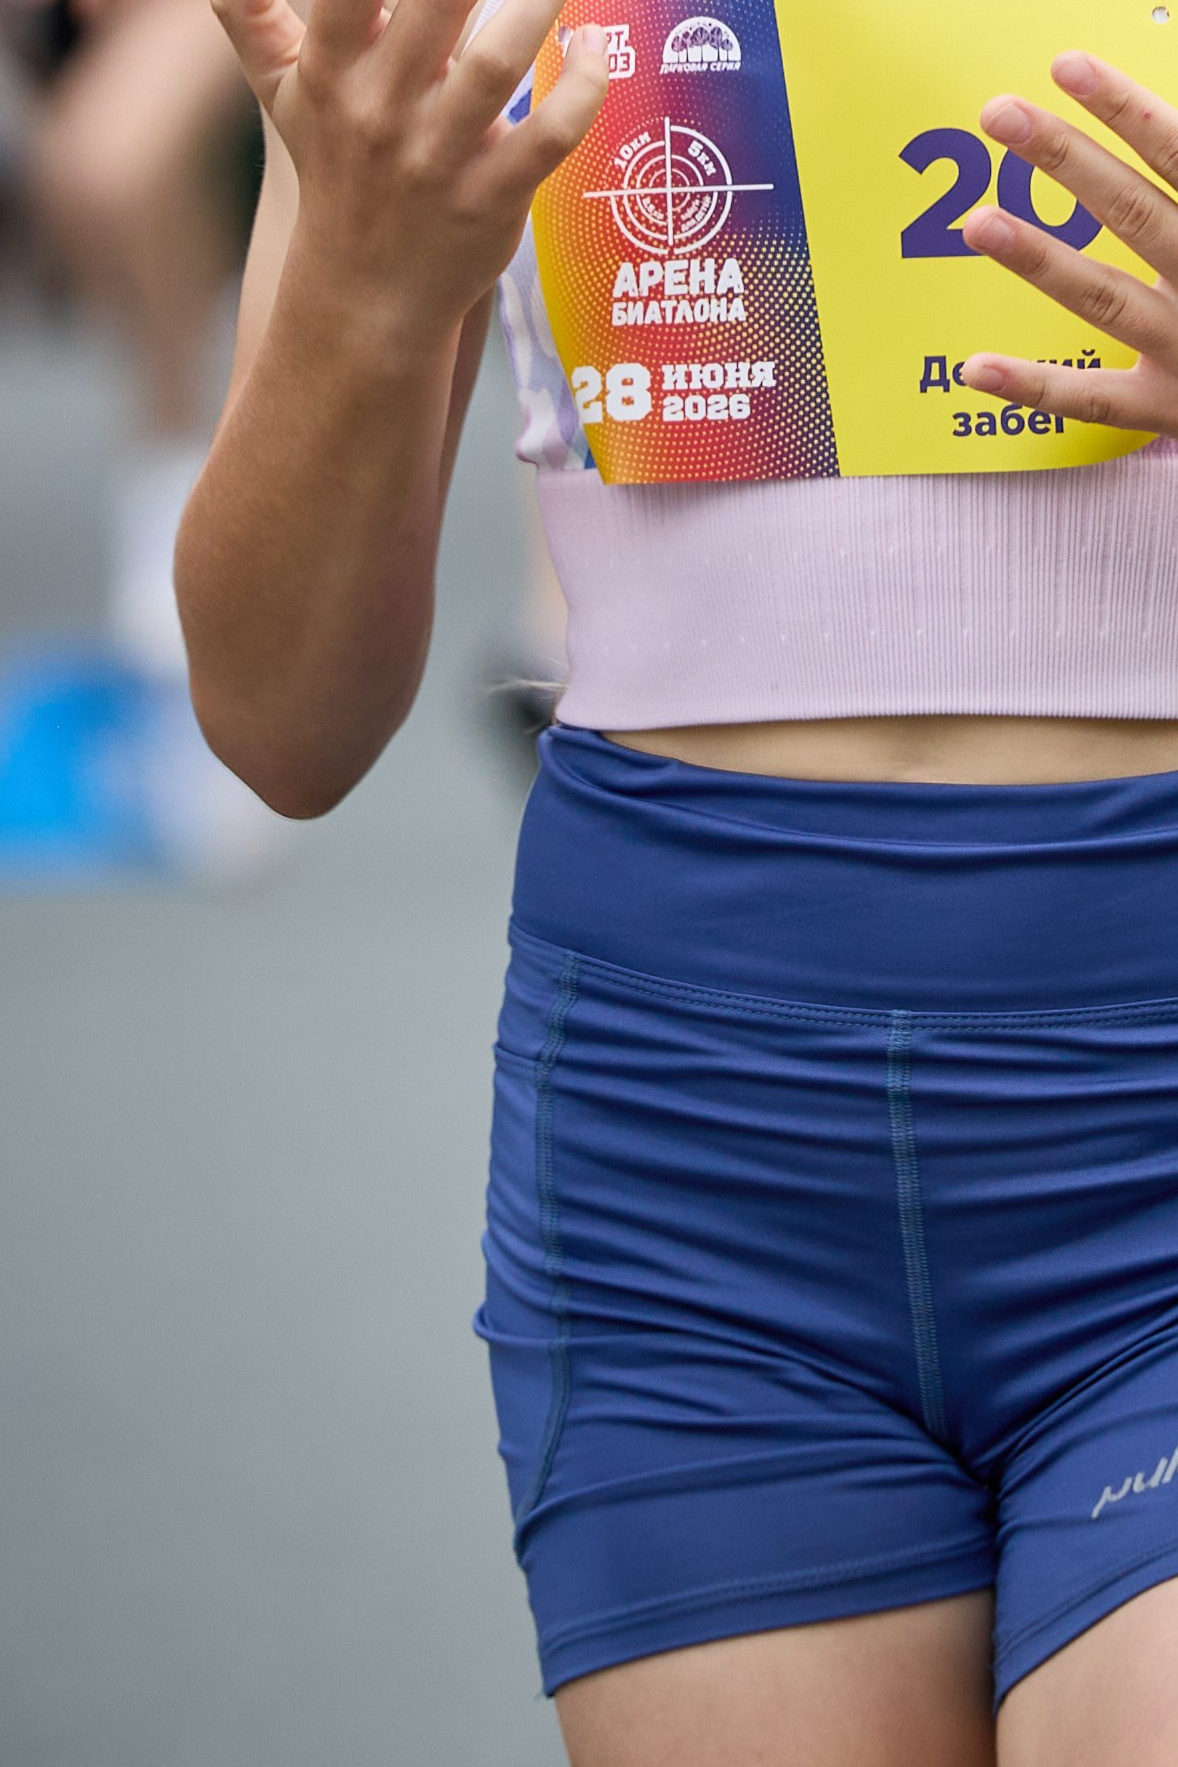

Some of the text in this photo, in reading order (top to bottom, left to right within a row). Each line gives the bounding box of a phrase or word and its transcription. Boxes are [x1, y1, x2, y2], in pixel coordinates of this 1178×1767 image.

[612, 257, 745, 298] АРЕНА
[611, 297, 747, 327] БИАТЛОНА
[570, 361, 777, 424] 28 ИЮНЯ
[662, 393, 751, 422] 2026
